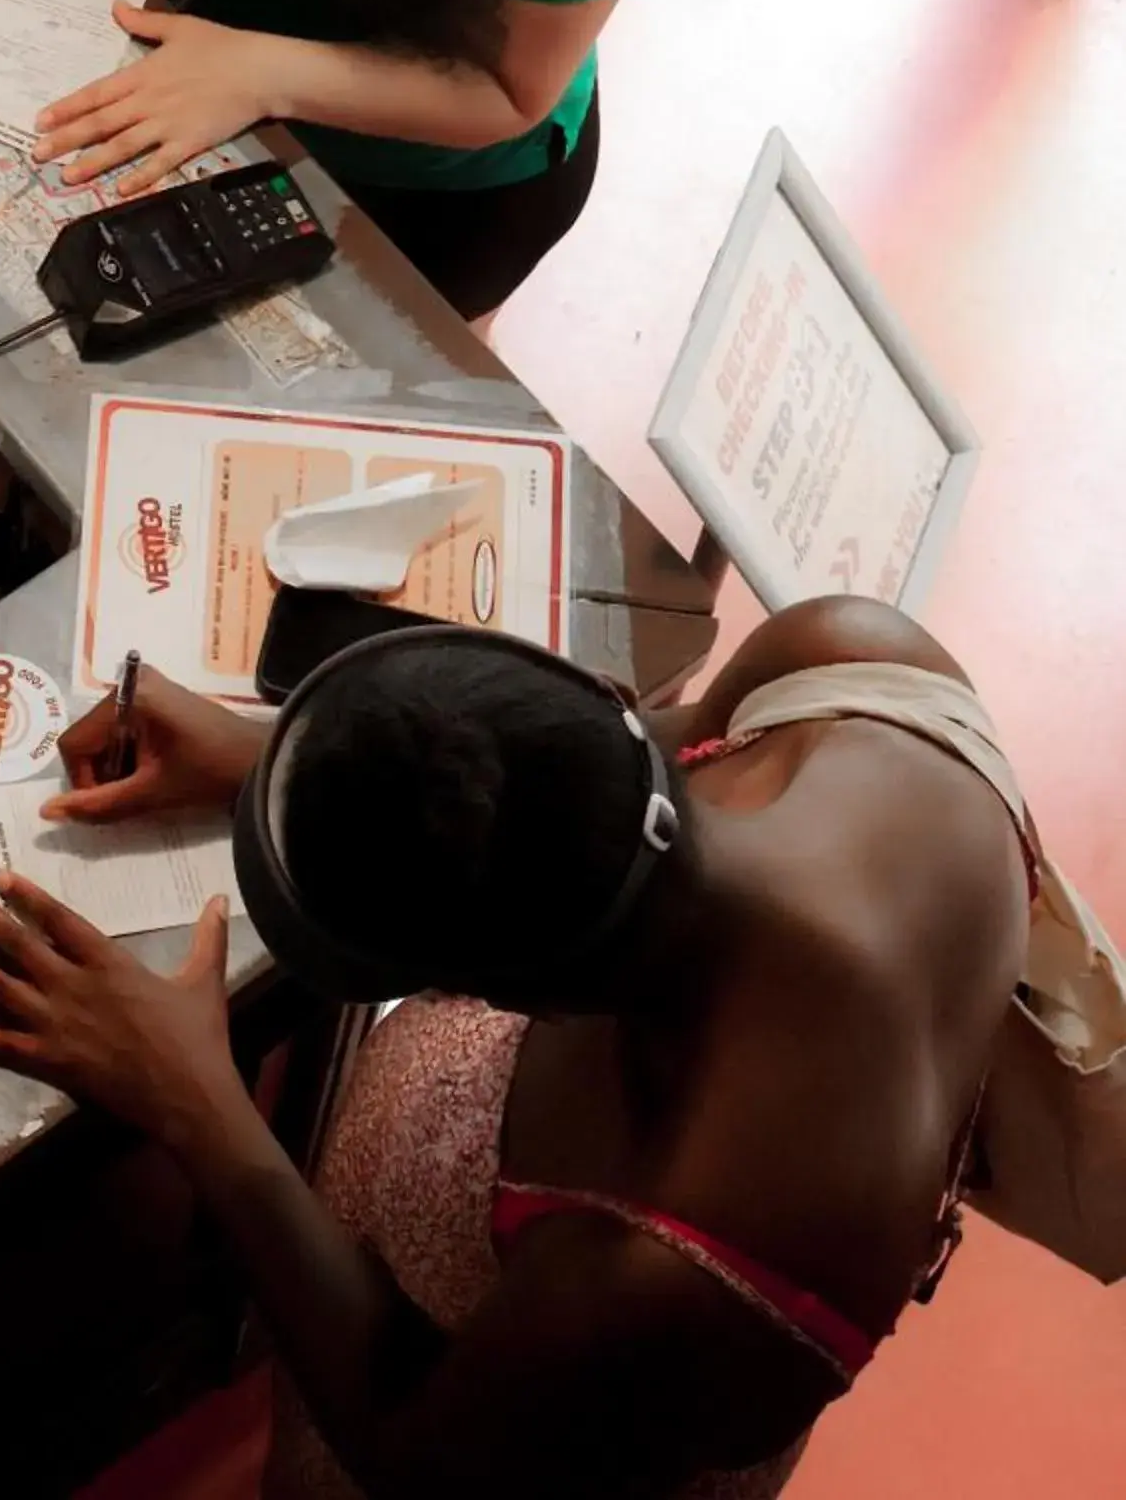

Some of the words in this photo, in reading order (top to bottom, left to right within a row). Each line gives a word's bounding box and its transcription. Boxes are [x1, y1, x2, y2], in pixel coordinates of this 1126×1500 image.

[715, 271, 772, 404] BEFORE
[716, 262, 806, 474] CHECKING-IN
[751, 401, 792, 499] STEP
[138, 497, 171, 594] VERTIGO
[168, 503, 182, 546] HOSTEL
